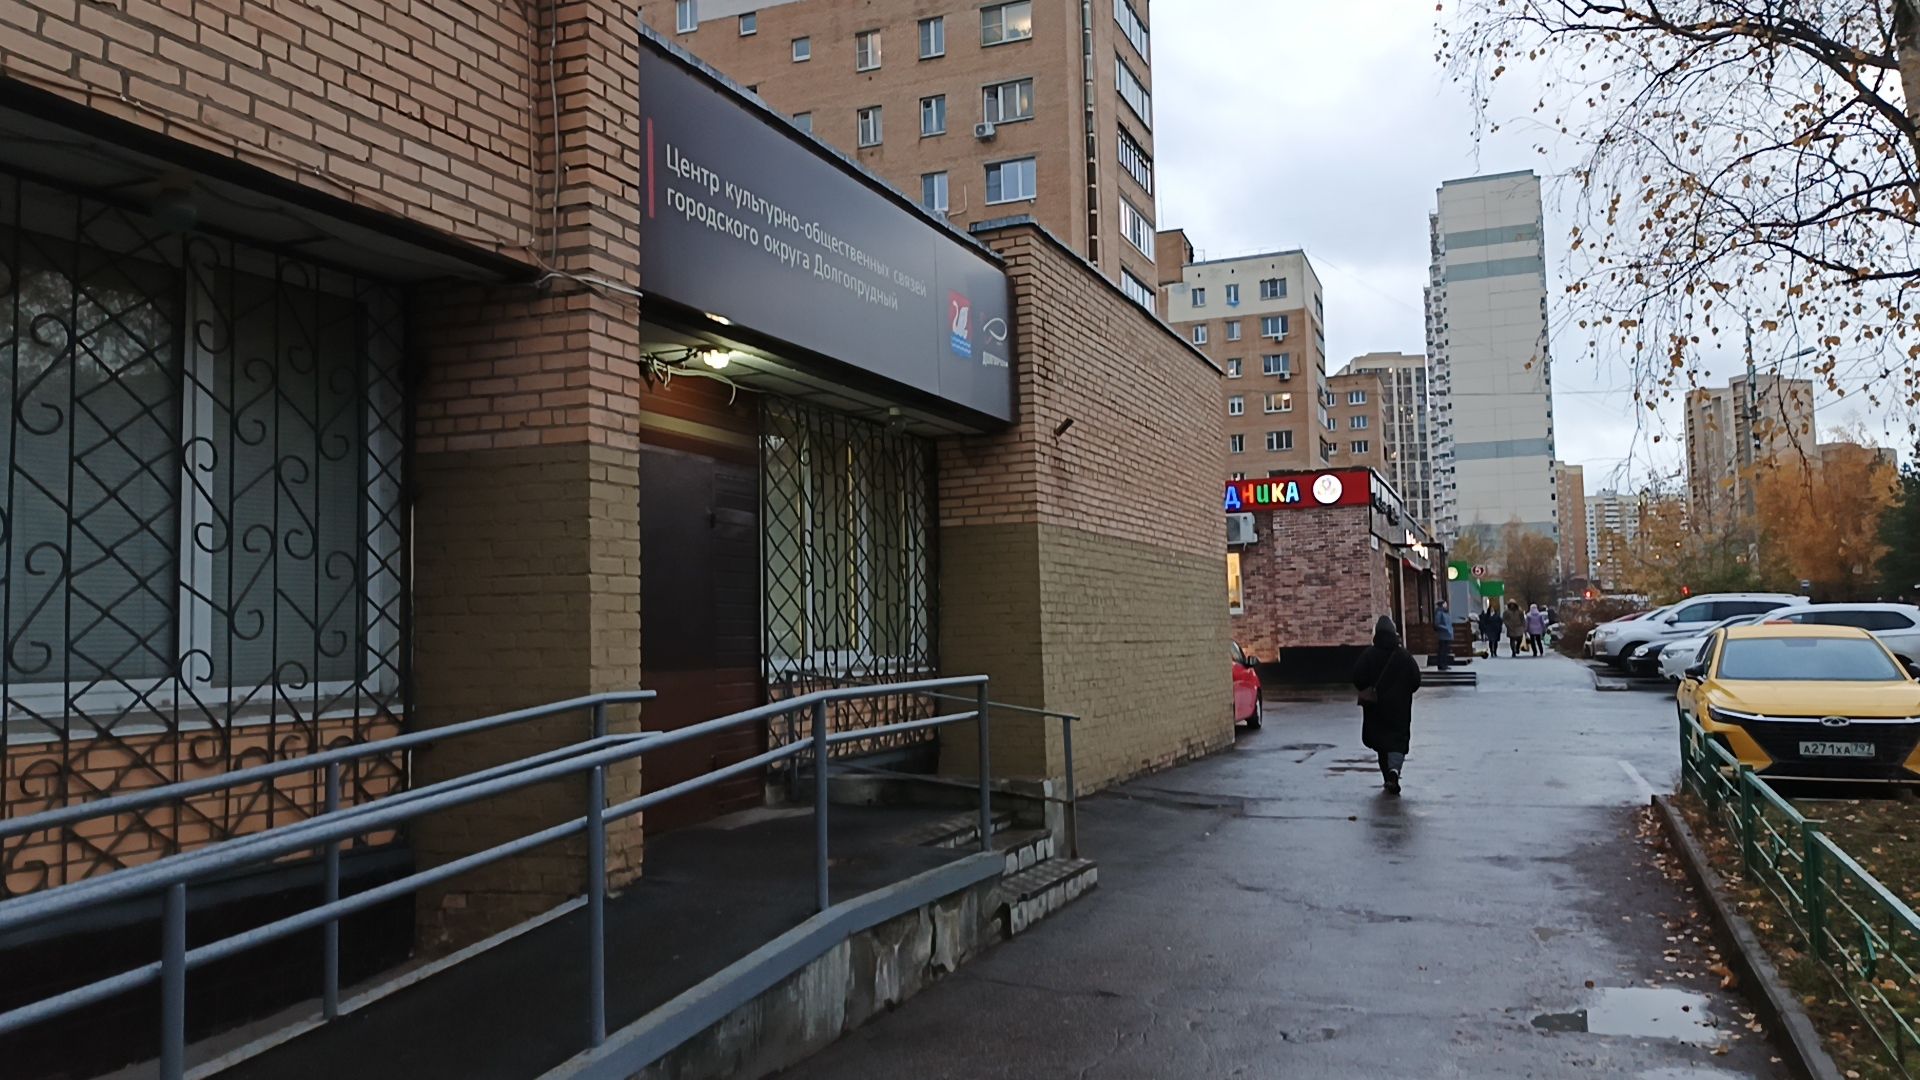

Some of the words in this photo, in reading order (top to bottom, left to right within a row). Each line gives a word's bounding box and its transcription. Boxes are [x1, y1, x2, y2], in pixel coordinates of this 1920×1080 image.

[666, 143, 720, 196] Центр
[725, 180, 889, 278] культурно-общественных
[893, 269, 927, 298] связей
[666, 187, 759, 246] городского
[763, 234, 810, 269] округа
[813, 253, 898, 311] Долгопрудный
